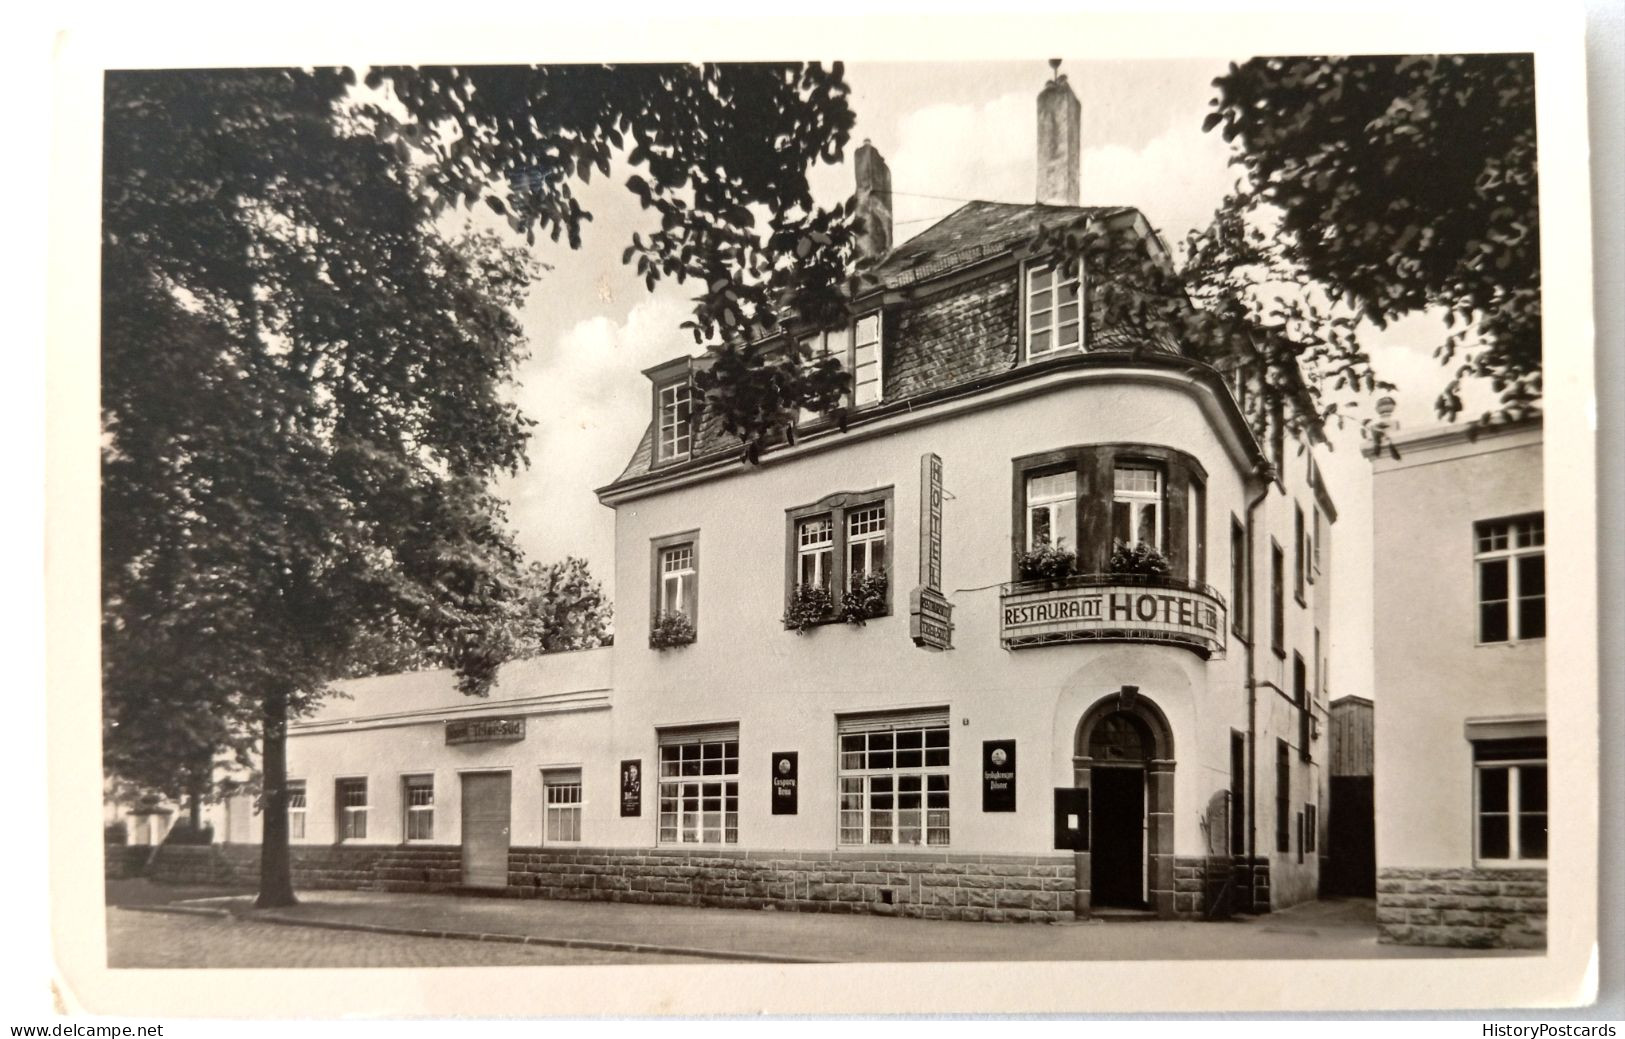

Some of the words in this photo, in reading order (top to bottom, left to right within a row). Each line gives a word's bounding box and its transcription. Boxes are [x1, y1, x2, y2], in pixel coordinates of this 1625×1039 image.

[930, 460, 941, 587] HOTEL
[1005, 600, 1101, 625] RESTAURANT
[1109, 594, 1204, 629] HOTEL
